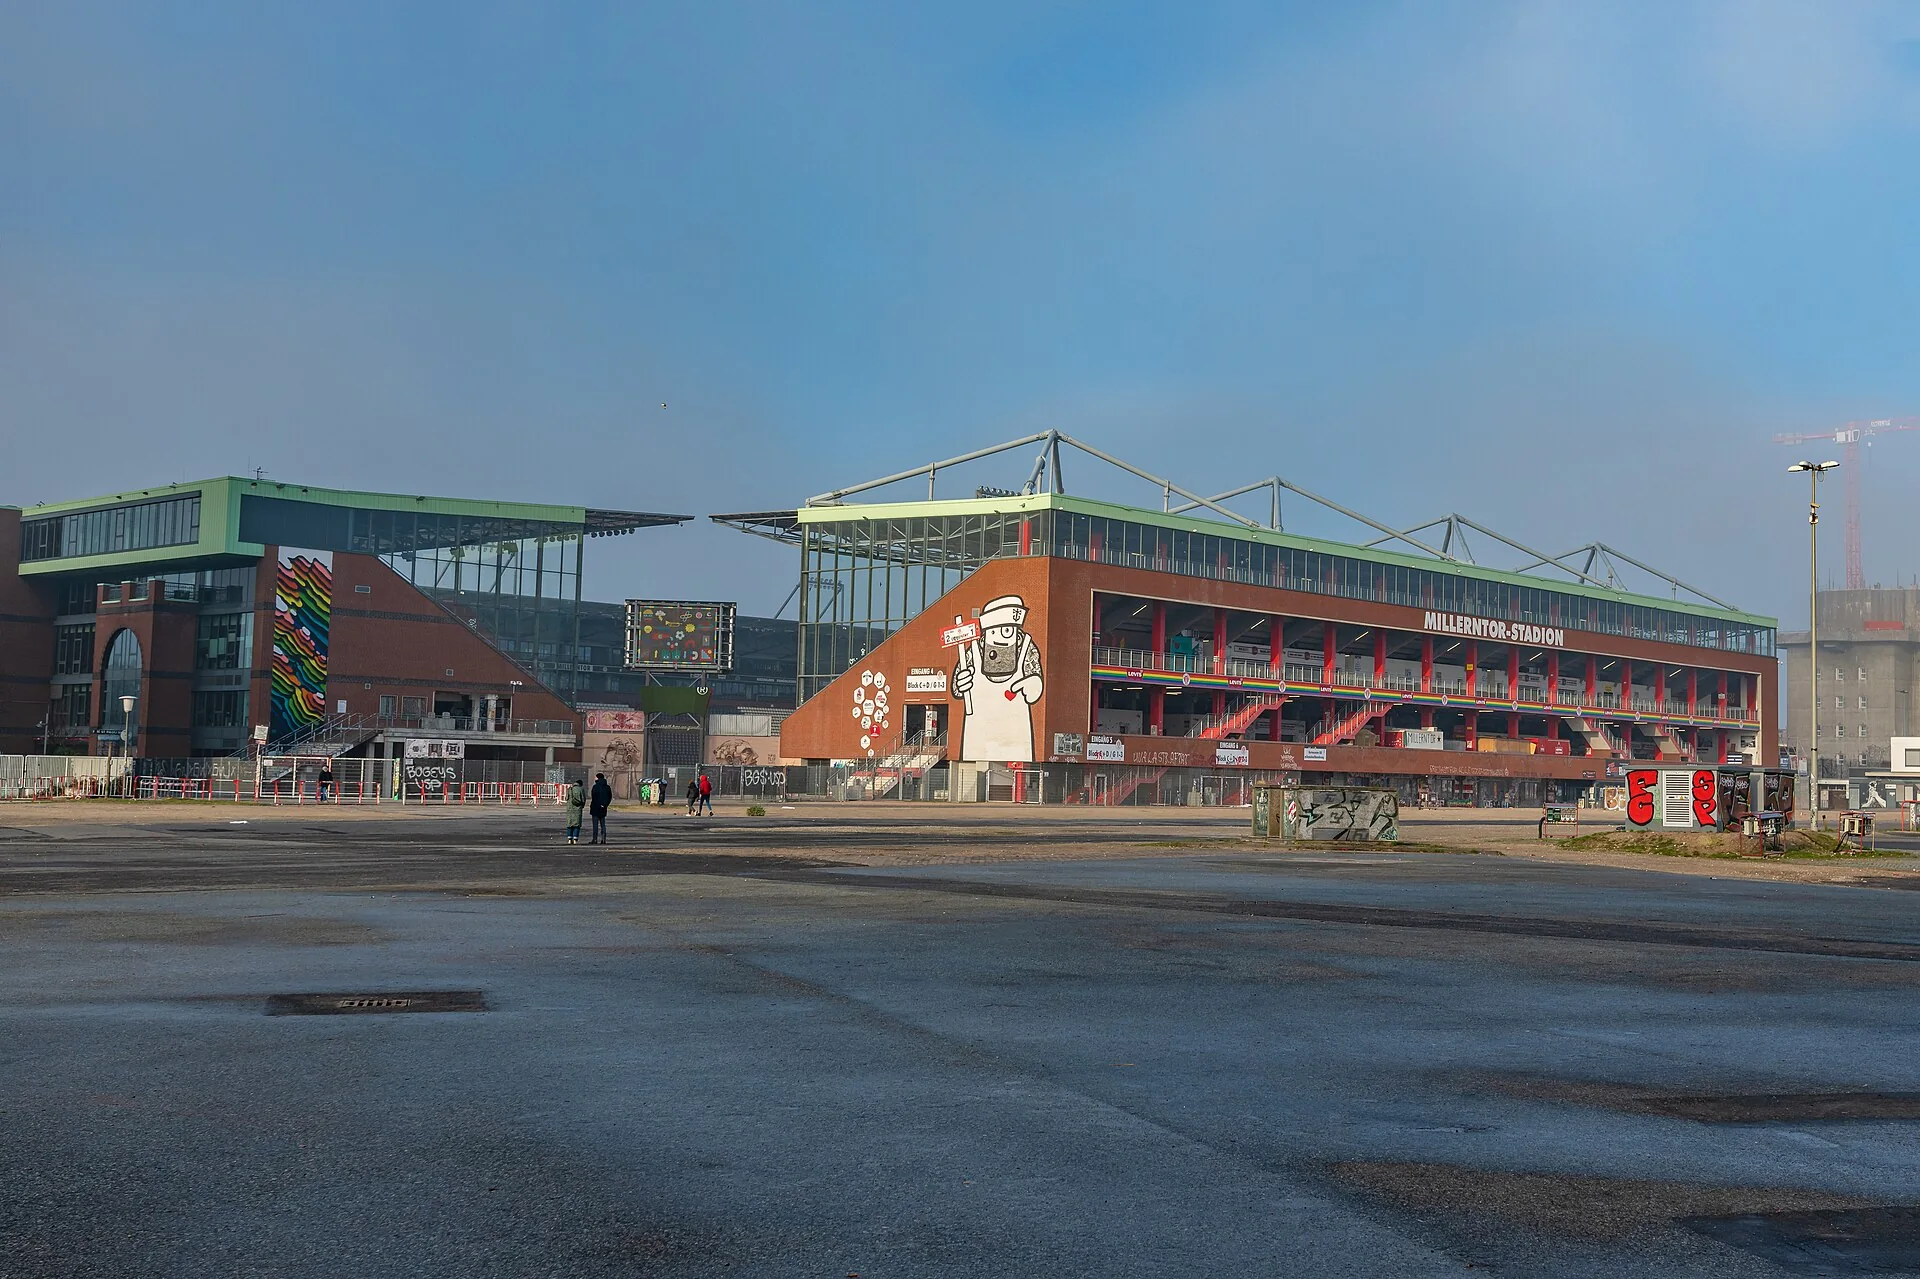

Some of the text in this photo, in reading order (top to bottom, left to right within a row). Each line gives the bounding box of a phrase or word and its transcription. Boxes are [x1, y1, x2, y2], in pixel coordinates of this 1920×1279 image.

[1424, 611, 1564, 646] MILLERNTOR-STADION
[1408, 733, 1436, 743] MILLERNTOR
[406, 766, 456, 779] BOGEYS
